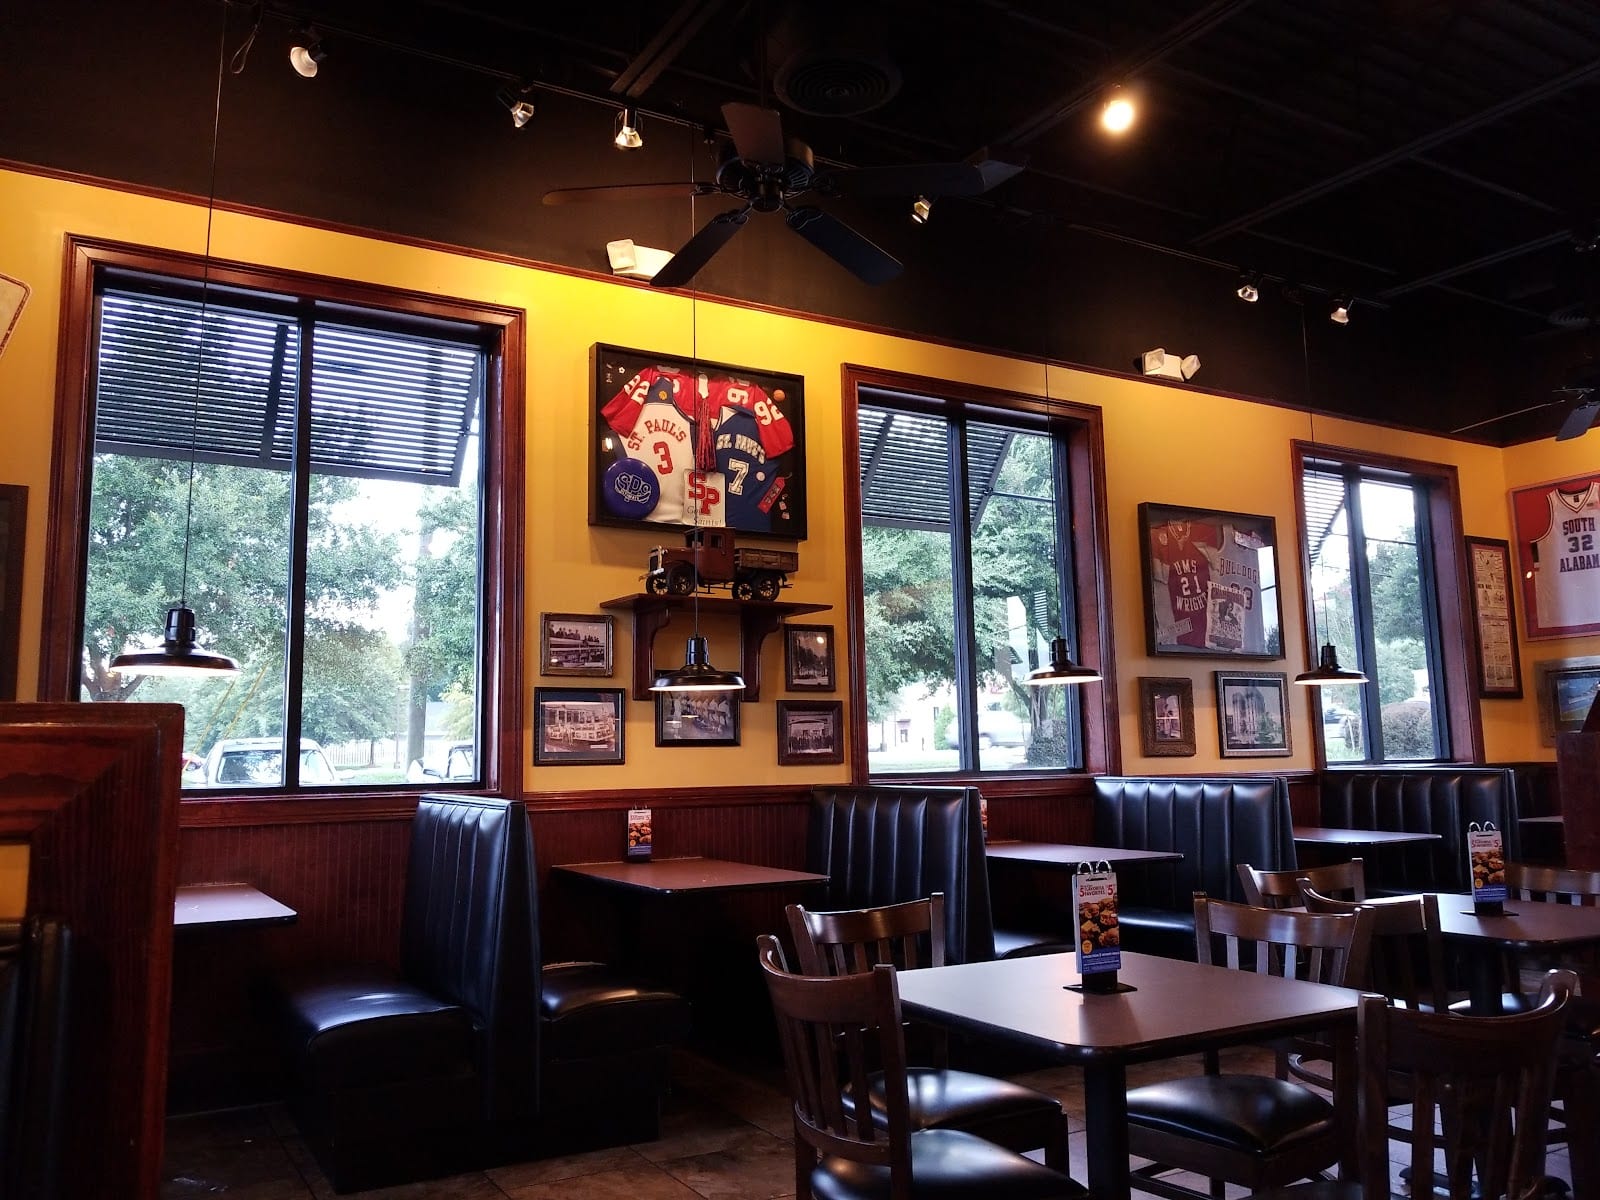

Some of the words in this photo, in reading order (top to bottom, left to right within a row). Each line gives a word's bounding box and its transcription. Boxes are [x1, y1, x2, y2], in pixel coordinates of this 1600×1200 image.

[644, 418, 687, 442] PAUL'S
[653, 441, 674, 475] 3
[728, 457, 750, 495] 7
[687, 470, 721, 516] SP
[1562, 517, 1596, 536] SOUTH
[1567, 534, 1594, 553] 32
[1174, 559, 1197, 576] UMS
[1180, 576, 1202, 596] 21
